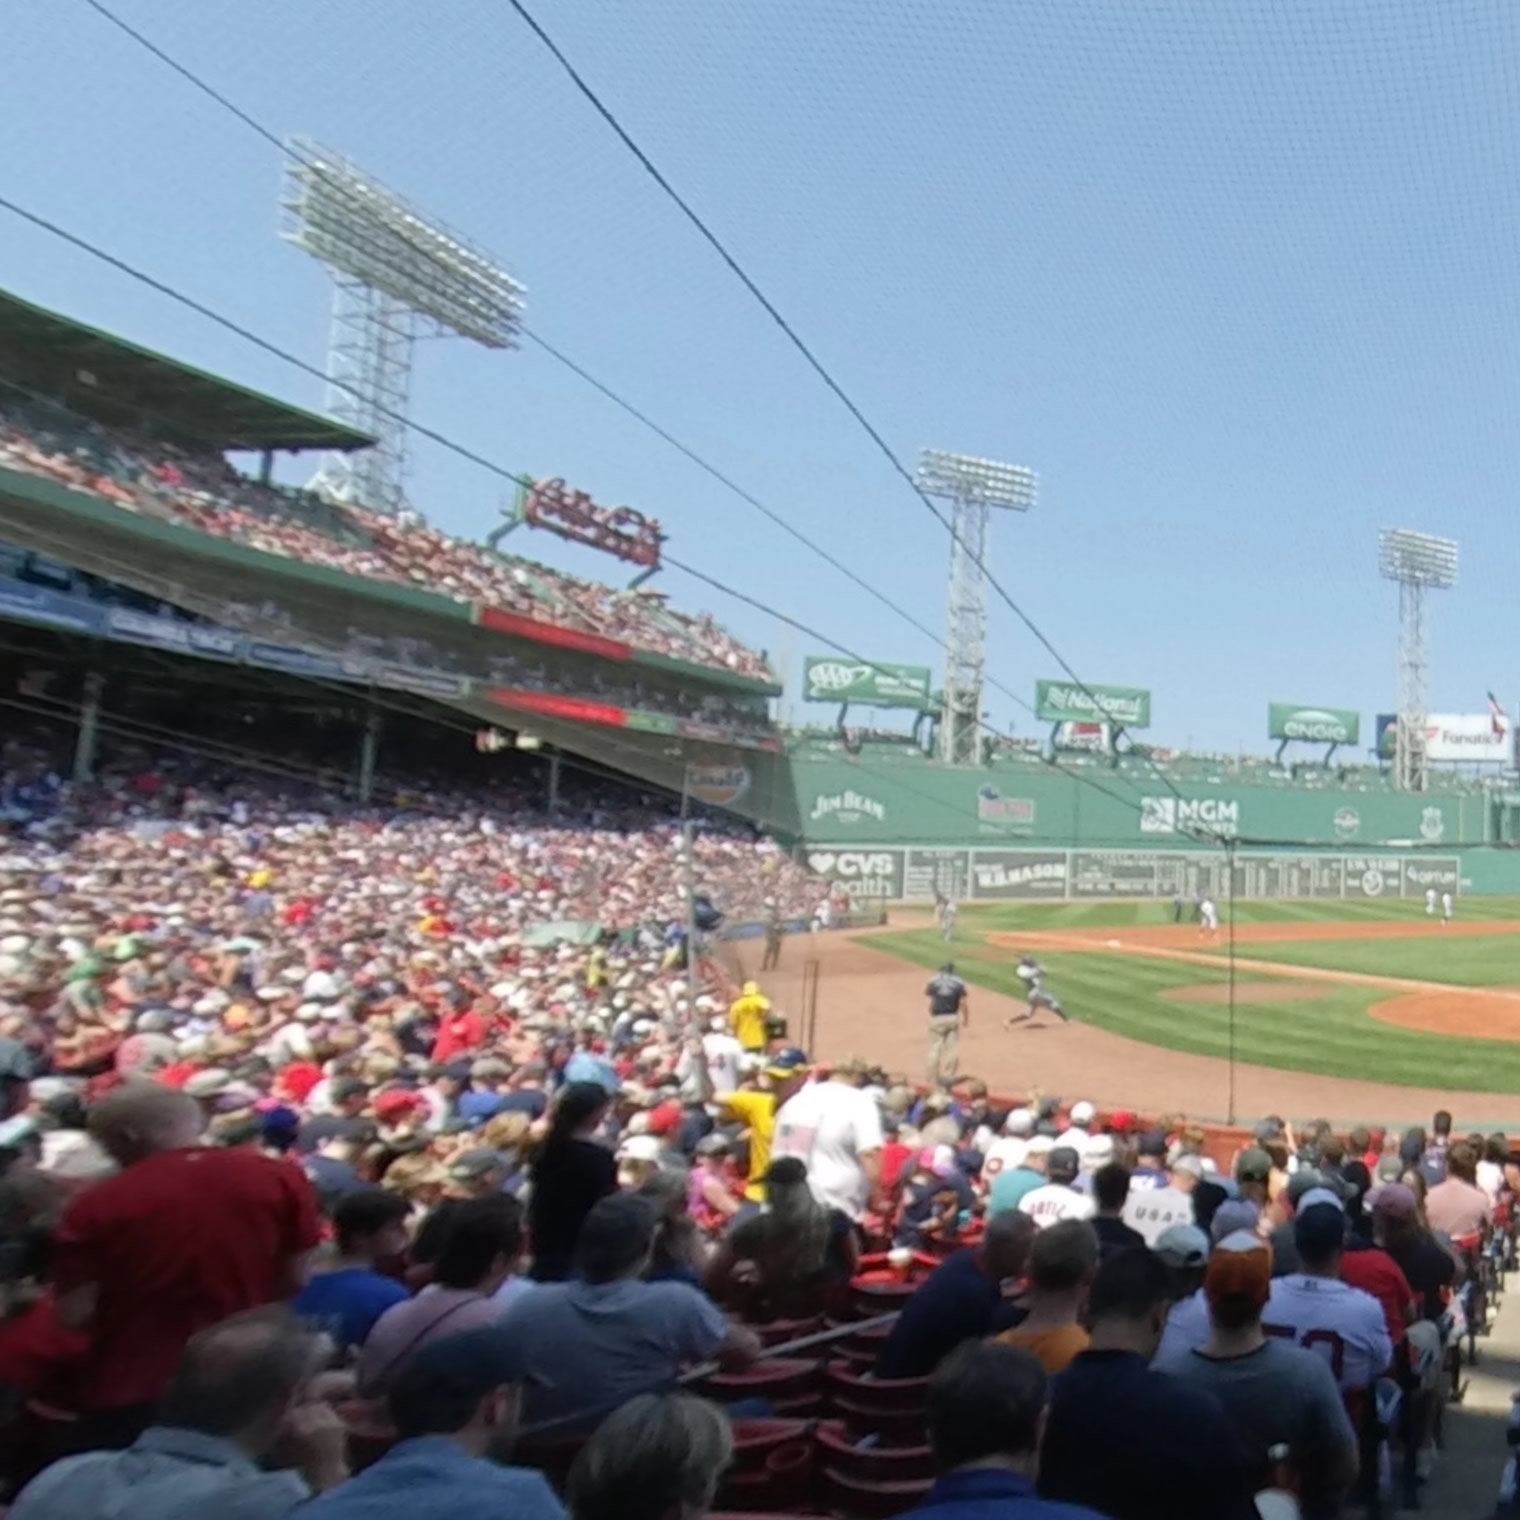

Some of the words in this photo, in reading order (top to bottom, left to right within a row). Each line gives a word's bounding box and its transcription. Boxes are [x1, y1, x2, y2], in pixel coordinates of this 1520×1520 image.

[1067, 690, 1140, 713] National
[811, 796, 841, 820] JIM
[844, 790, 884, 820] BEAM
[1178, 799, 1238, 821] MGM
[837, 853, 893, 875] CVS
